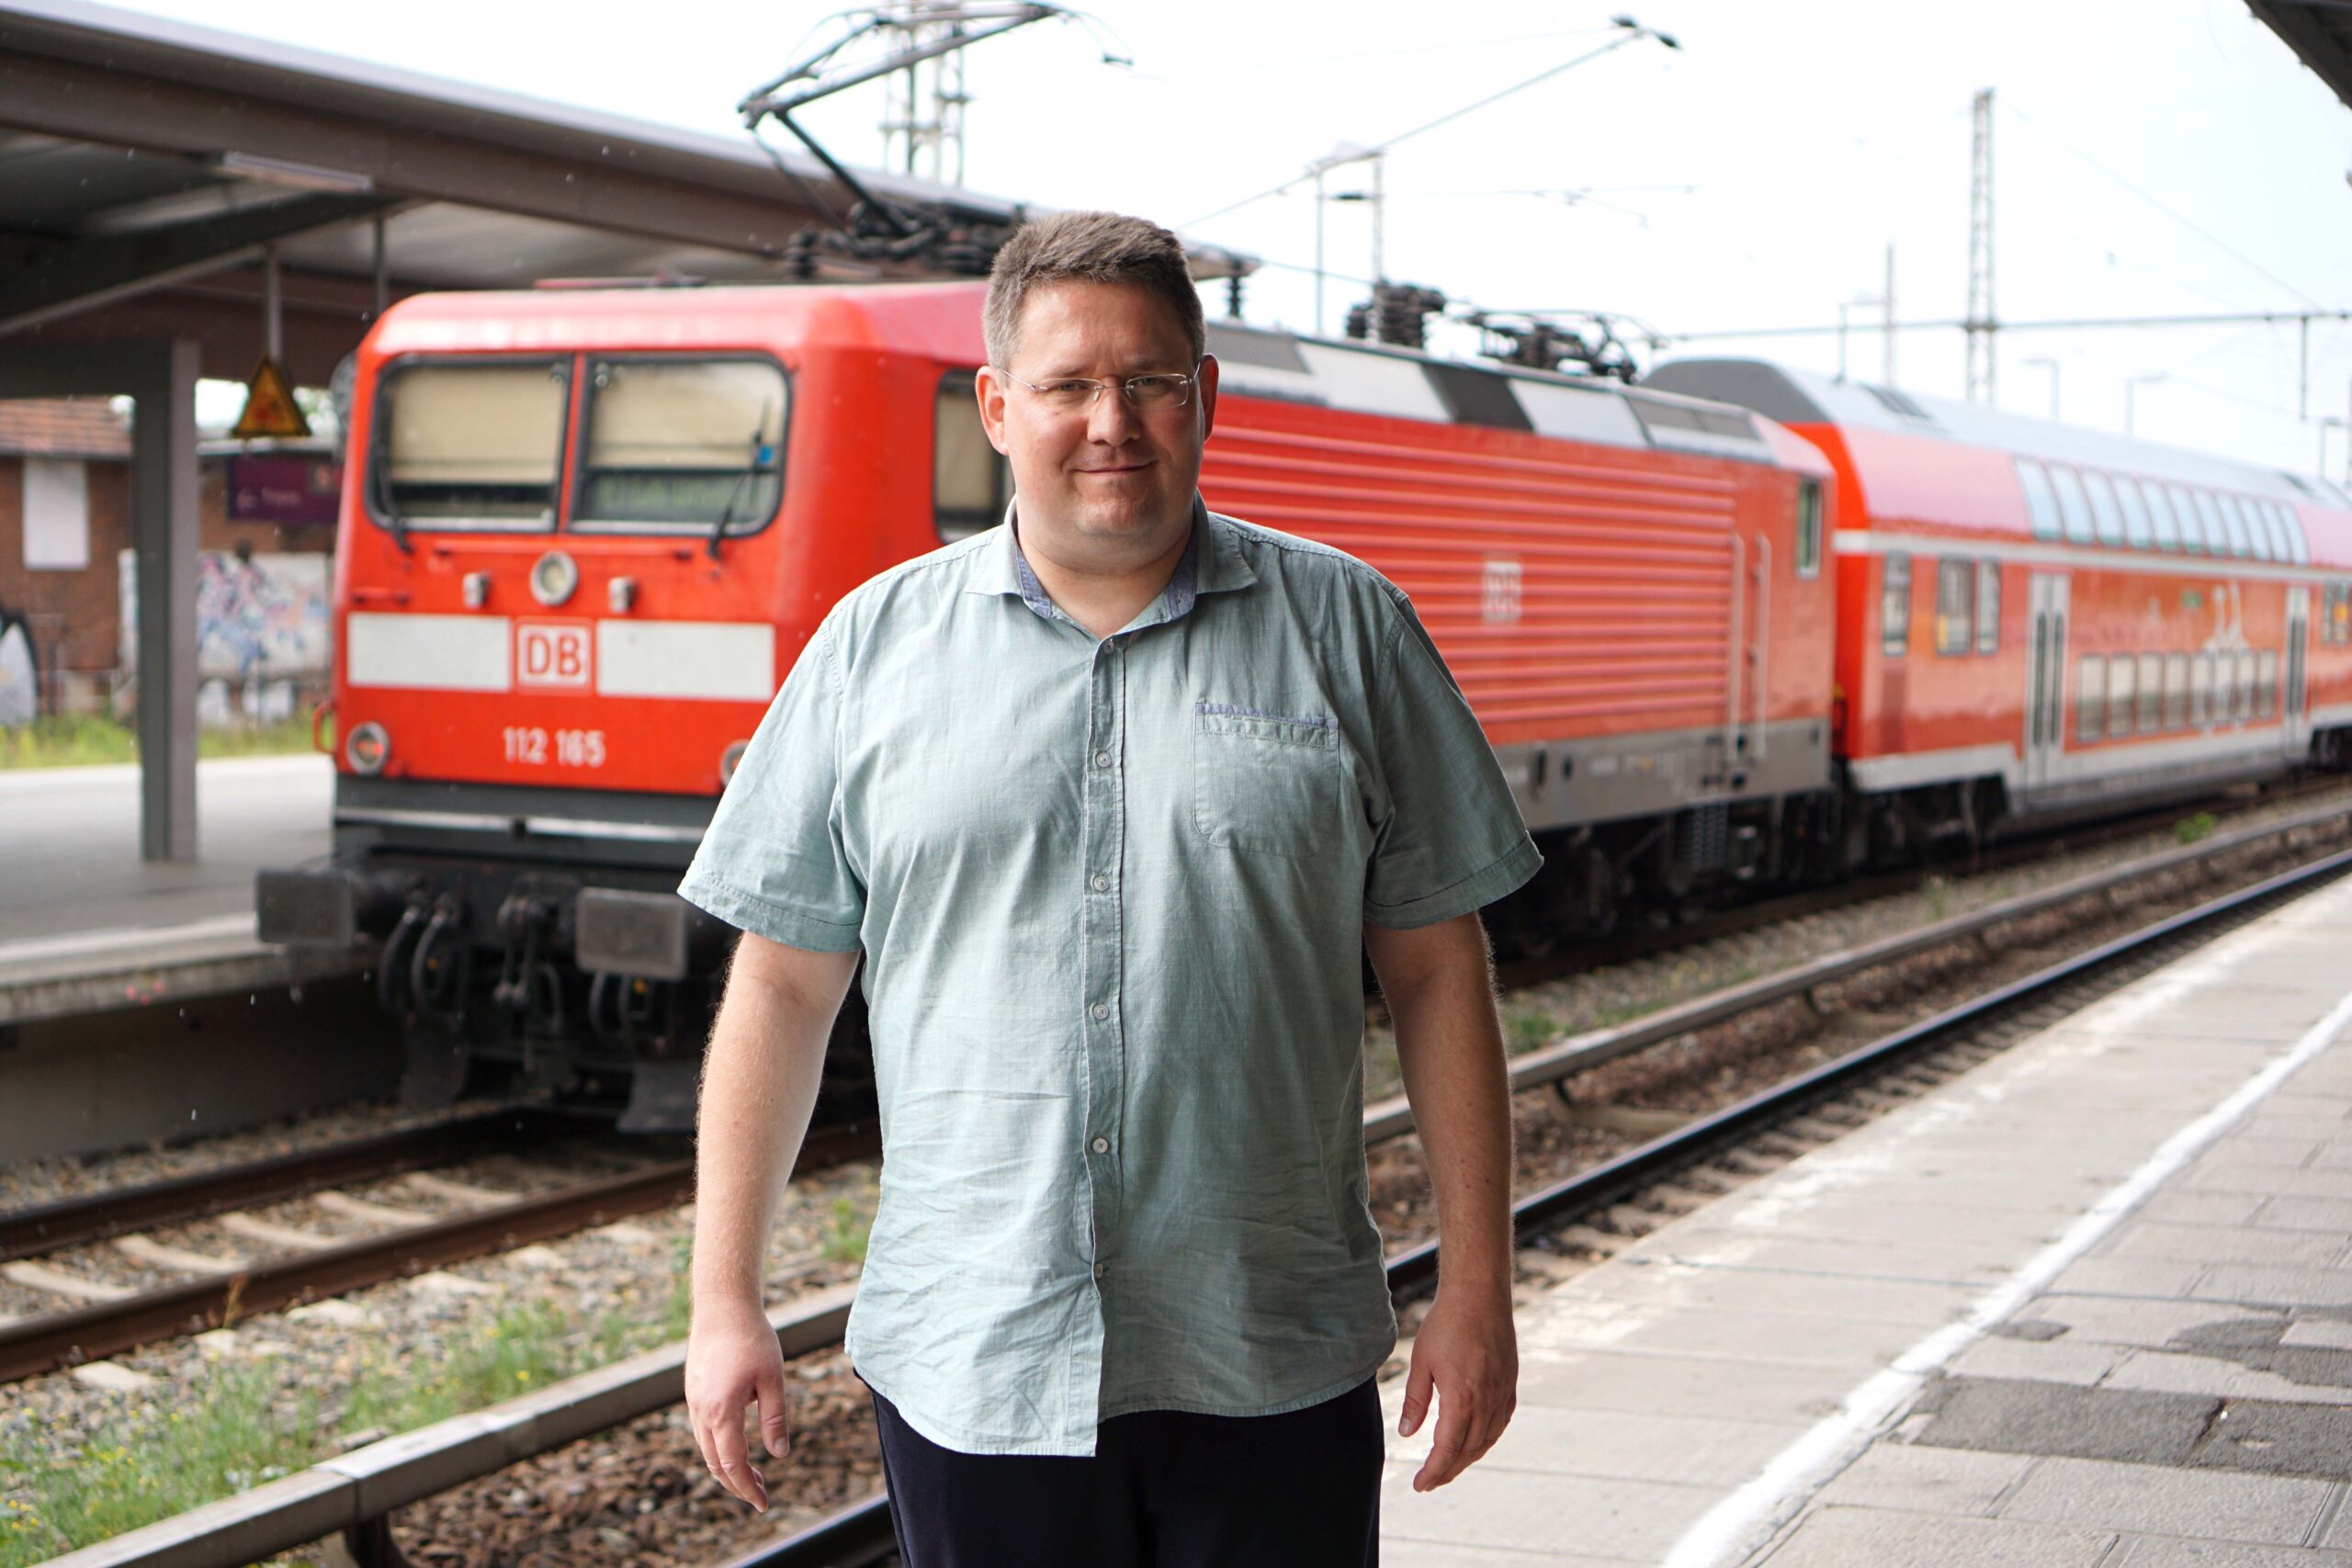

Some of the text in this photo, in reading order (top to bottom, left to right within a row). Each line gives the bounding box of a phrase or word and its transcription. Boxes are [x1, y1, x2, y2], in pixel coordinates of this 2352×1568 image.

[527, 633, 581, 675] DB
[503, 727, 606, 768] 112 165
